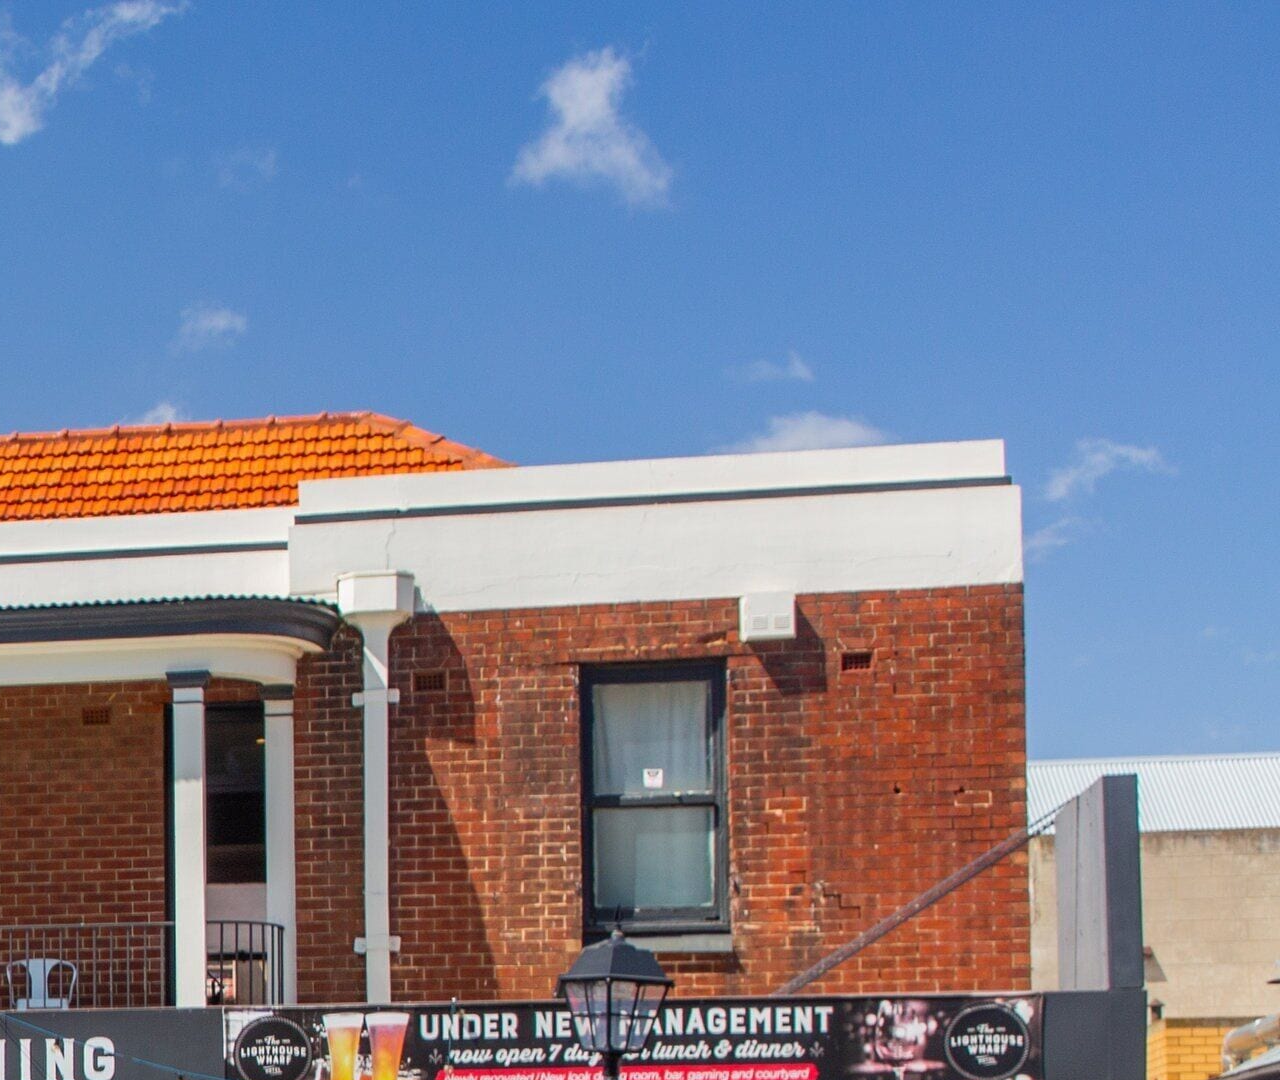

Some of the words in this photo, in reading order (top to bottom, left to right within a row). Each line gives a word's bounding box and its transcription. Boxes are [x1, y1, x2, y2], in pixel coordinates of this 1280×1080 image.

[420, 1011, 518, 1040] UNDER
[619, 1005, 834, 1037] MANAGEMENT
[950, 1034, 1023, 1048] LIGHTHOUSE
[241, 1046, 307, 1059] LIGHTHOUSE
[449, 1049, 493, 1064] now
[495, 1047, 546, 1067] open
[548, 1043, 563, 1064] 7
[563, 1043, 603, 1067] day
[652, 1040, 712, 1060] lunch
[713, 1039, 733, 1059] &
[735, 1039, 805, 1060] dinner
[967, 1044, 1007, 1055] WHARF
[256, 1054, 292, 1066] WHARF
[731, 1068, 753, 1080] and
